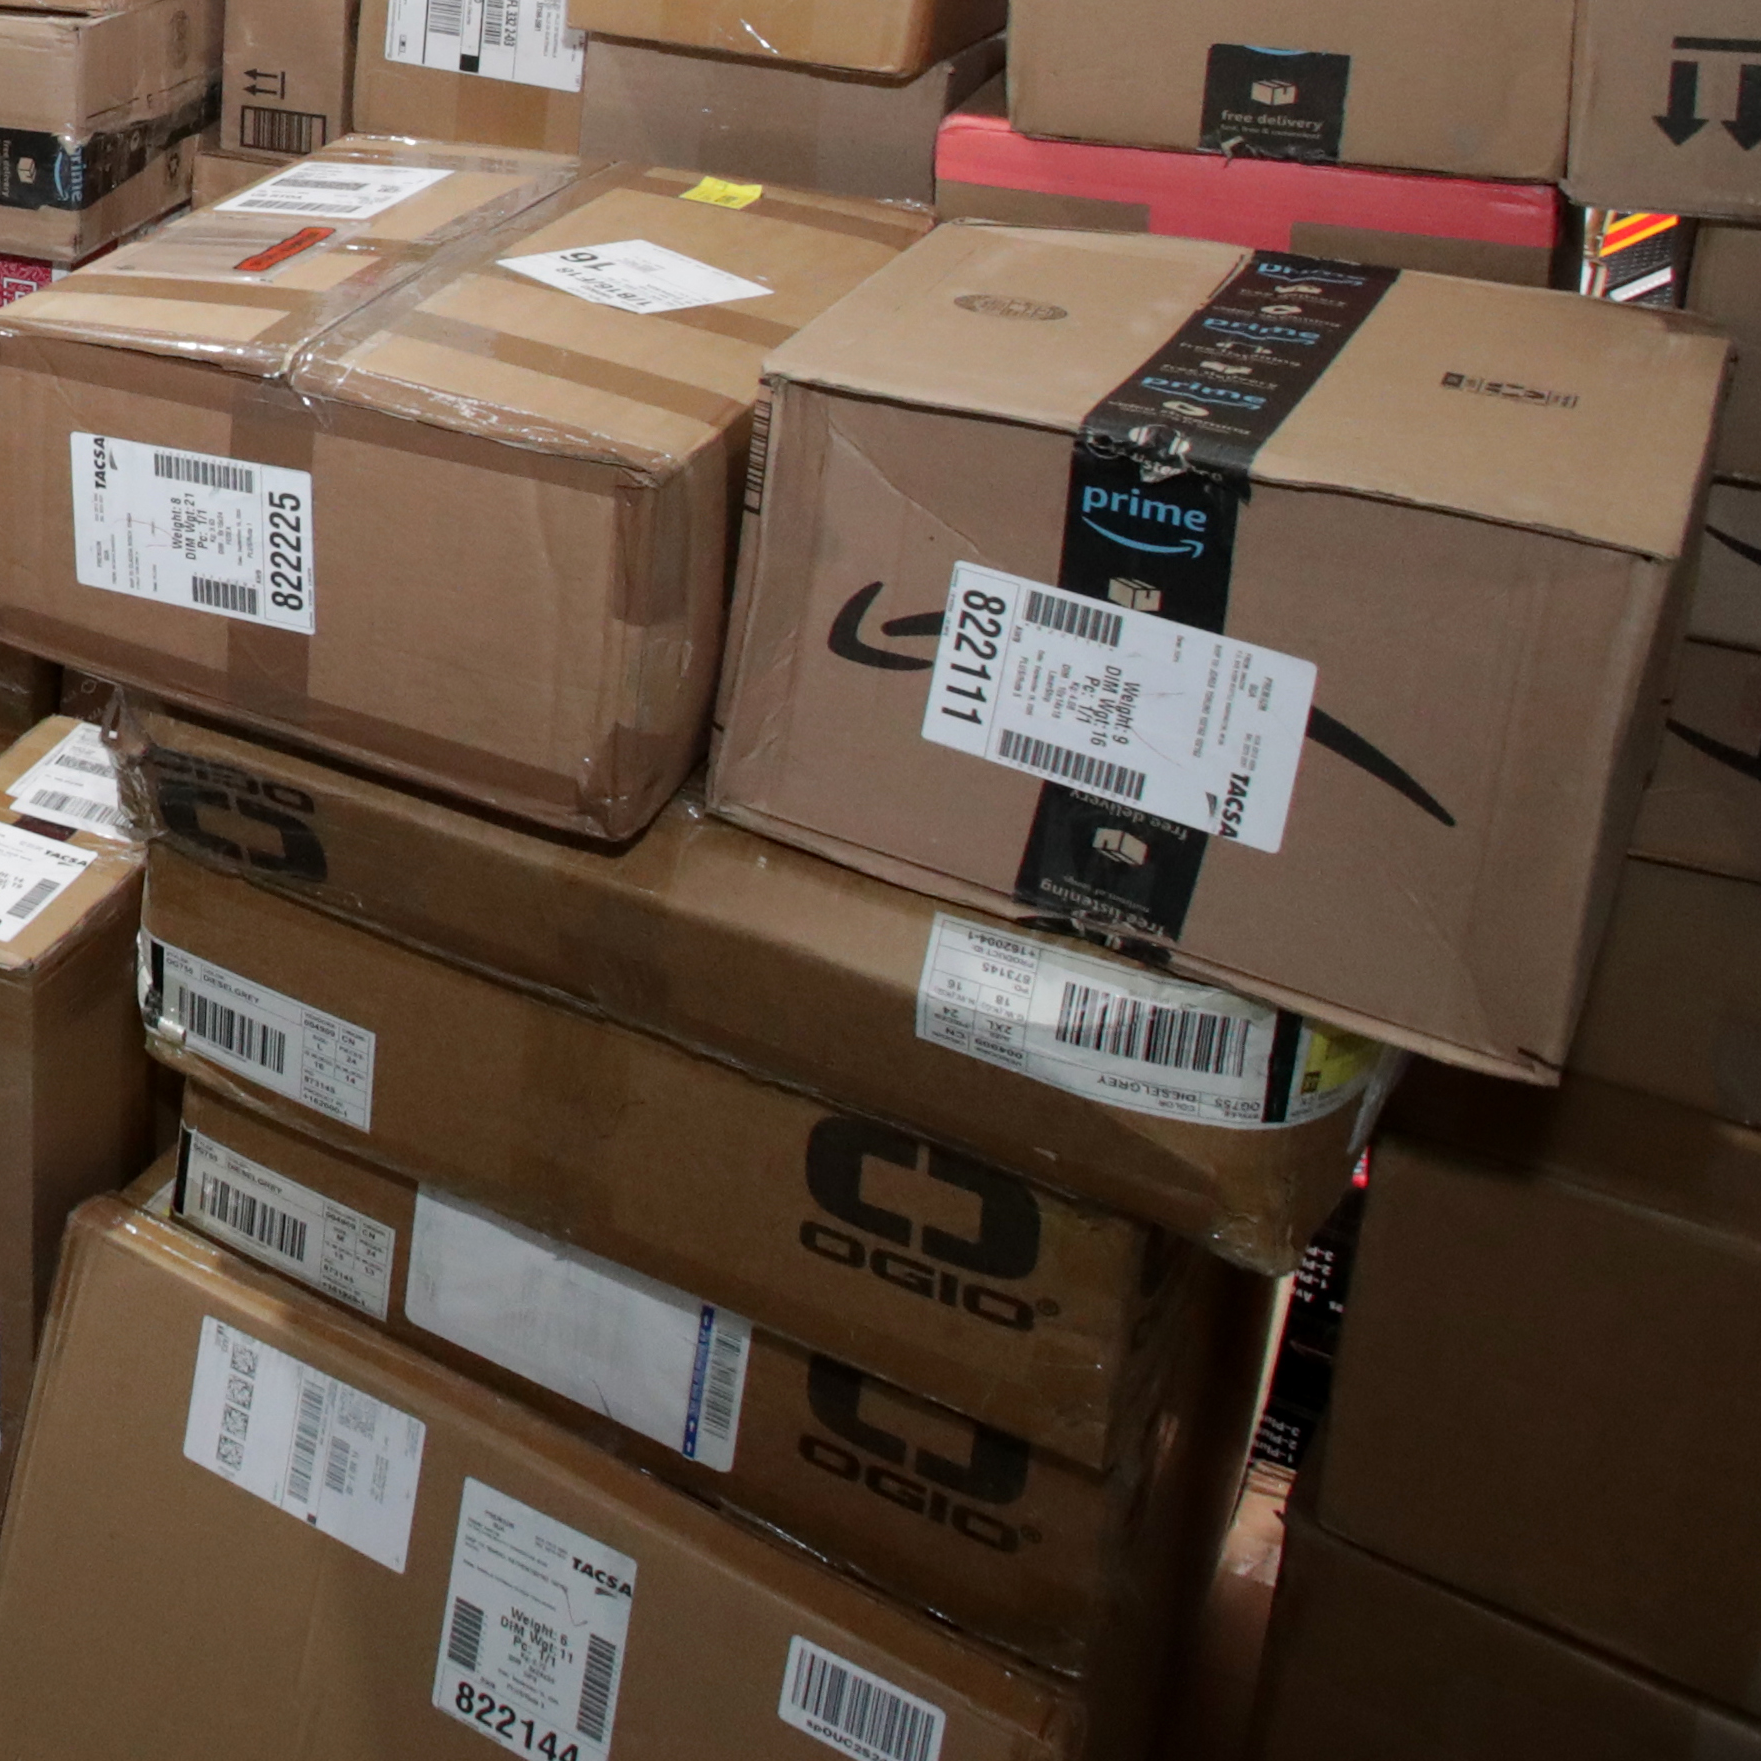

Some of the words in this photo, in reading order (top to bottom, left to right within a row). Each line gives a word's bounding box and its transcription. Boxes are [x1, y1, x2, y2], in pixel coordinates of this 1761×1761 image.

[1222, 110, 1255, 124] free
[1258, 113, 1324, 132] delivery
[2, 140, 11, 163] free
[0, 165, 10, 199] delivery
[560, 252, 616, 271] 16
[1203, 317, 1321, 341] prime
[1140, 377, 1267, 406] prime
[93, 437, 106, 490] TACSA
[170, 497, 182, 505] 8
[184, 492, 195, 503] 21
[1082, 486, 1207, 532] prime
[171, 506, 184, 550] Weight:
[185, 503, 196, 538] Wgt:
[197, 509, 208, 525] 1/1
[185, 538, 197, 560] DIM
[197, 531, 208, 550] Pc:
[268, 491, 304, 611] 822225
[941, 589, 1006, 725] 822111
[1042, 669, 1058, 703] LaserShip
[1087, 676, 1101, 697] Pc:
[1106, 665, 1123, 697] DIM
[1076, 702, 1093, 724] 1/1
[1097, 698, 1115, 732] Wgt:
[1117, 681, 1141, 732] Weight:
[1090, 732, 1106, 747] 16
[1118, 733, 1130, 746] 9
[1069, 788, 1146, 825] delivery
[1217, 771, 1251, 839] TACSA
[1148, 814, 1189, 842] free
[43, 848, 88, 867] TACSA
[1039, 877, 1122, 926] listening
[1125, 911, 1166, 936] free
[981, 961, 1032, 984] 873145
[992, 952, 1036, 971] PRODUCT
[202, 973, 260, 1004] DIESELGREY
[947, 978, 963, 991] 16
[942, 1005, 959, 1017] 24
[994, 993, 1011, 1006] 18
[341, 1035, 356, 1046] CN
[944, 1026, 967, 1039] CN
[984, 1019, 1013, 1035] 2XL
[1097, 1075, 1197, 1102] DIESELGREY
[1215, 1098, 1261, 1114] OG755
[1158, 1099, 1197, 1114] COLOR
[227, 1161, 282, 1195] DIESELGREY
[362, 1229, 376, 1240] CN
[799, 1220, 1035, 1332] OGIO
[797, 1434, 1020, 1554] OGIO
[571, 1556, 633, 1597] TACSA
[510, 1606, 558, 1639] Weight:
[499, 1615, 525, 1636] DIM
[529, 1629, 557, 1653] Wgt:
[560, 1648, 574, 1664] 11
[513, 1634, 531, 1652] Pc:
[538, 1648, 556, 1668] 1/1
[454, 1681, 579, 1761] 822144
